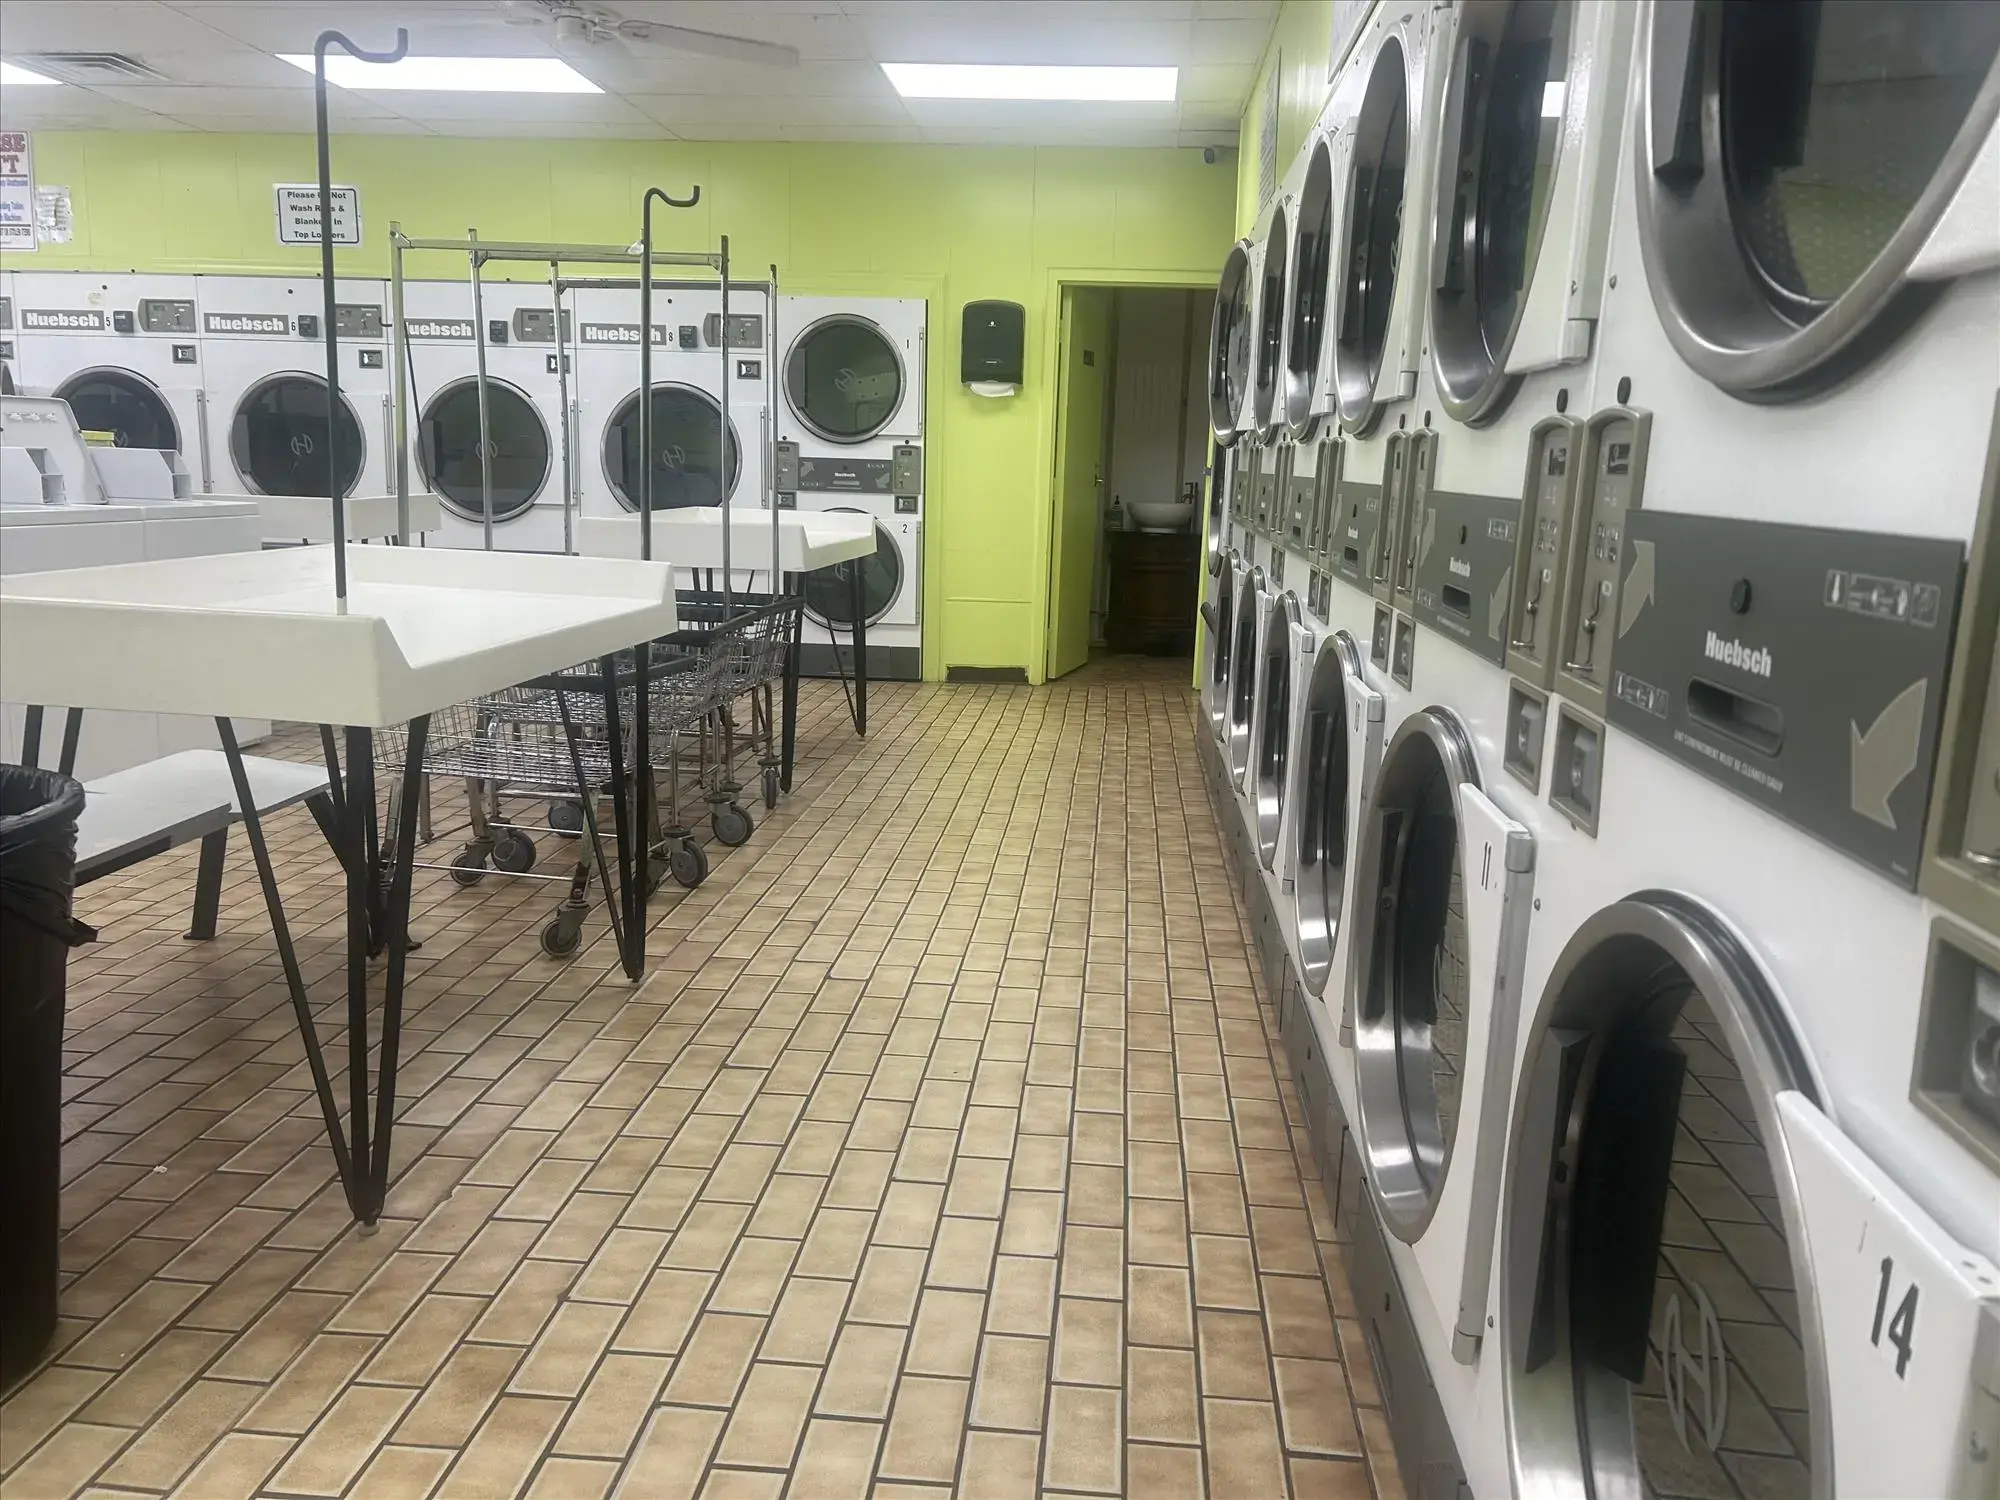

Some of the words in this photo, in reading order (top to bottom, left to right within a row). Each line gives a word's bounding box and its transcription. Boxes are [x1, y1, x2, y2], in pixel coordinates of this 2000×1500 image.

[287, 191, 315, 199] Please
[331, 191, 346, 199] Not
[290, 204, 313, 212] Wash
[293, 231, 309, 239] Top
[311, 231, 345, 239] Loers
[26, 312, 100, 327] Huebsch
[105, 318, 111, 327] 5
[209, 316, 284, 331] Huebsch
[291, 322, 296, 331] 6
[405, 321, 472, 337] uebsch
[585, 326, 661, 341] Huebsh
[668, 332, 673, 342] 8
[902, 523, 908, 534] 2
[1704, 629, 1773, 678] Huebsch
[1481, 841, 1492, 891] 11
[1871, 1255, 1920, 1381] 14
